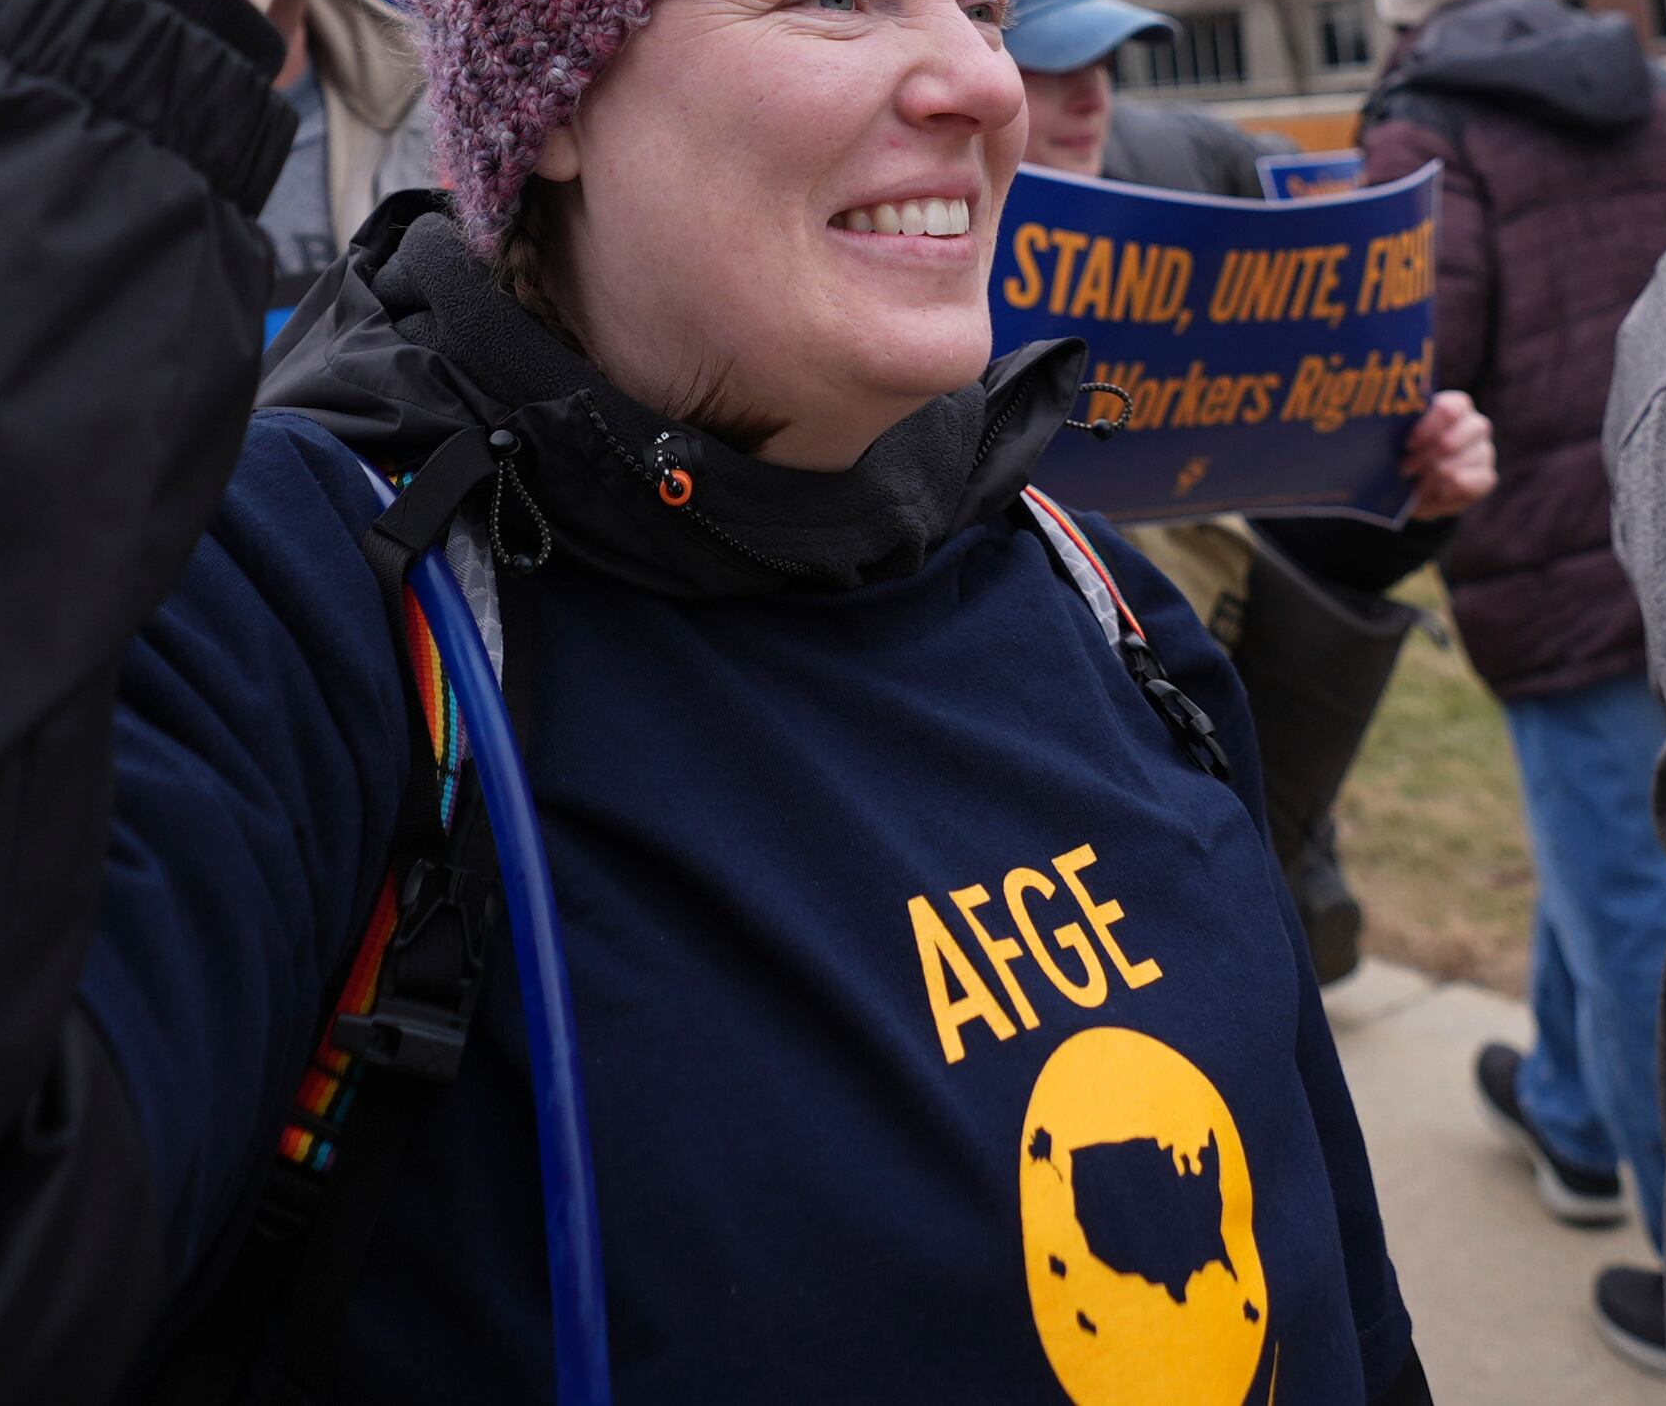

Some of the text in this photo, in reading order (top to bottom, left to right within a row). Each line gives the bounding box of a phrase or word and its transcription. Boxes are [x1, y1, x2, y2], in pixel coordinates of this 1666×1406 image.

[1004, 223, 1192, 334] STAND,
[1208, 242, 1349, 330] UNITE,
[1086, 339, 1434, 434] Workers Rights!
[907, 843, 1163, 1065] AFGE
